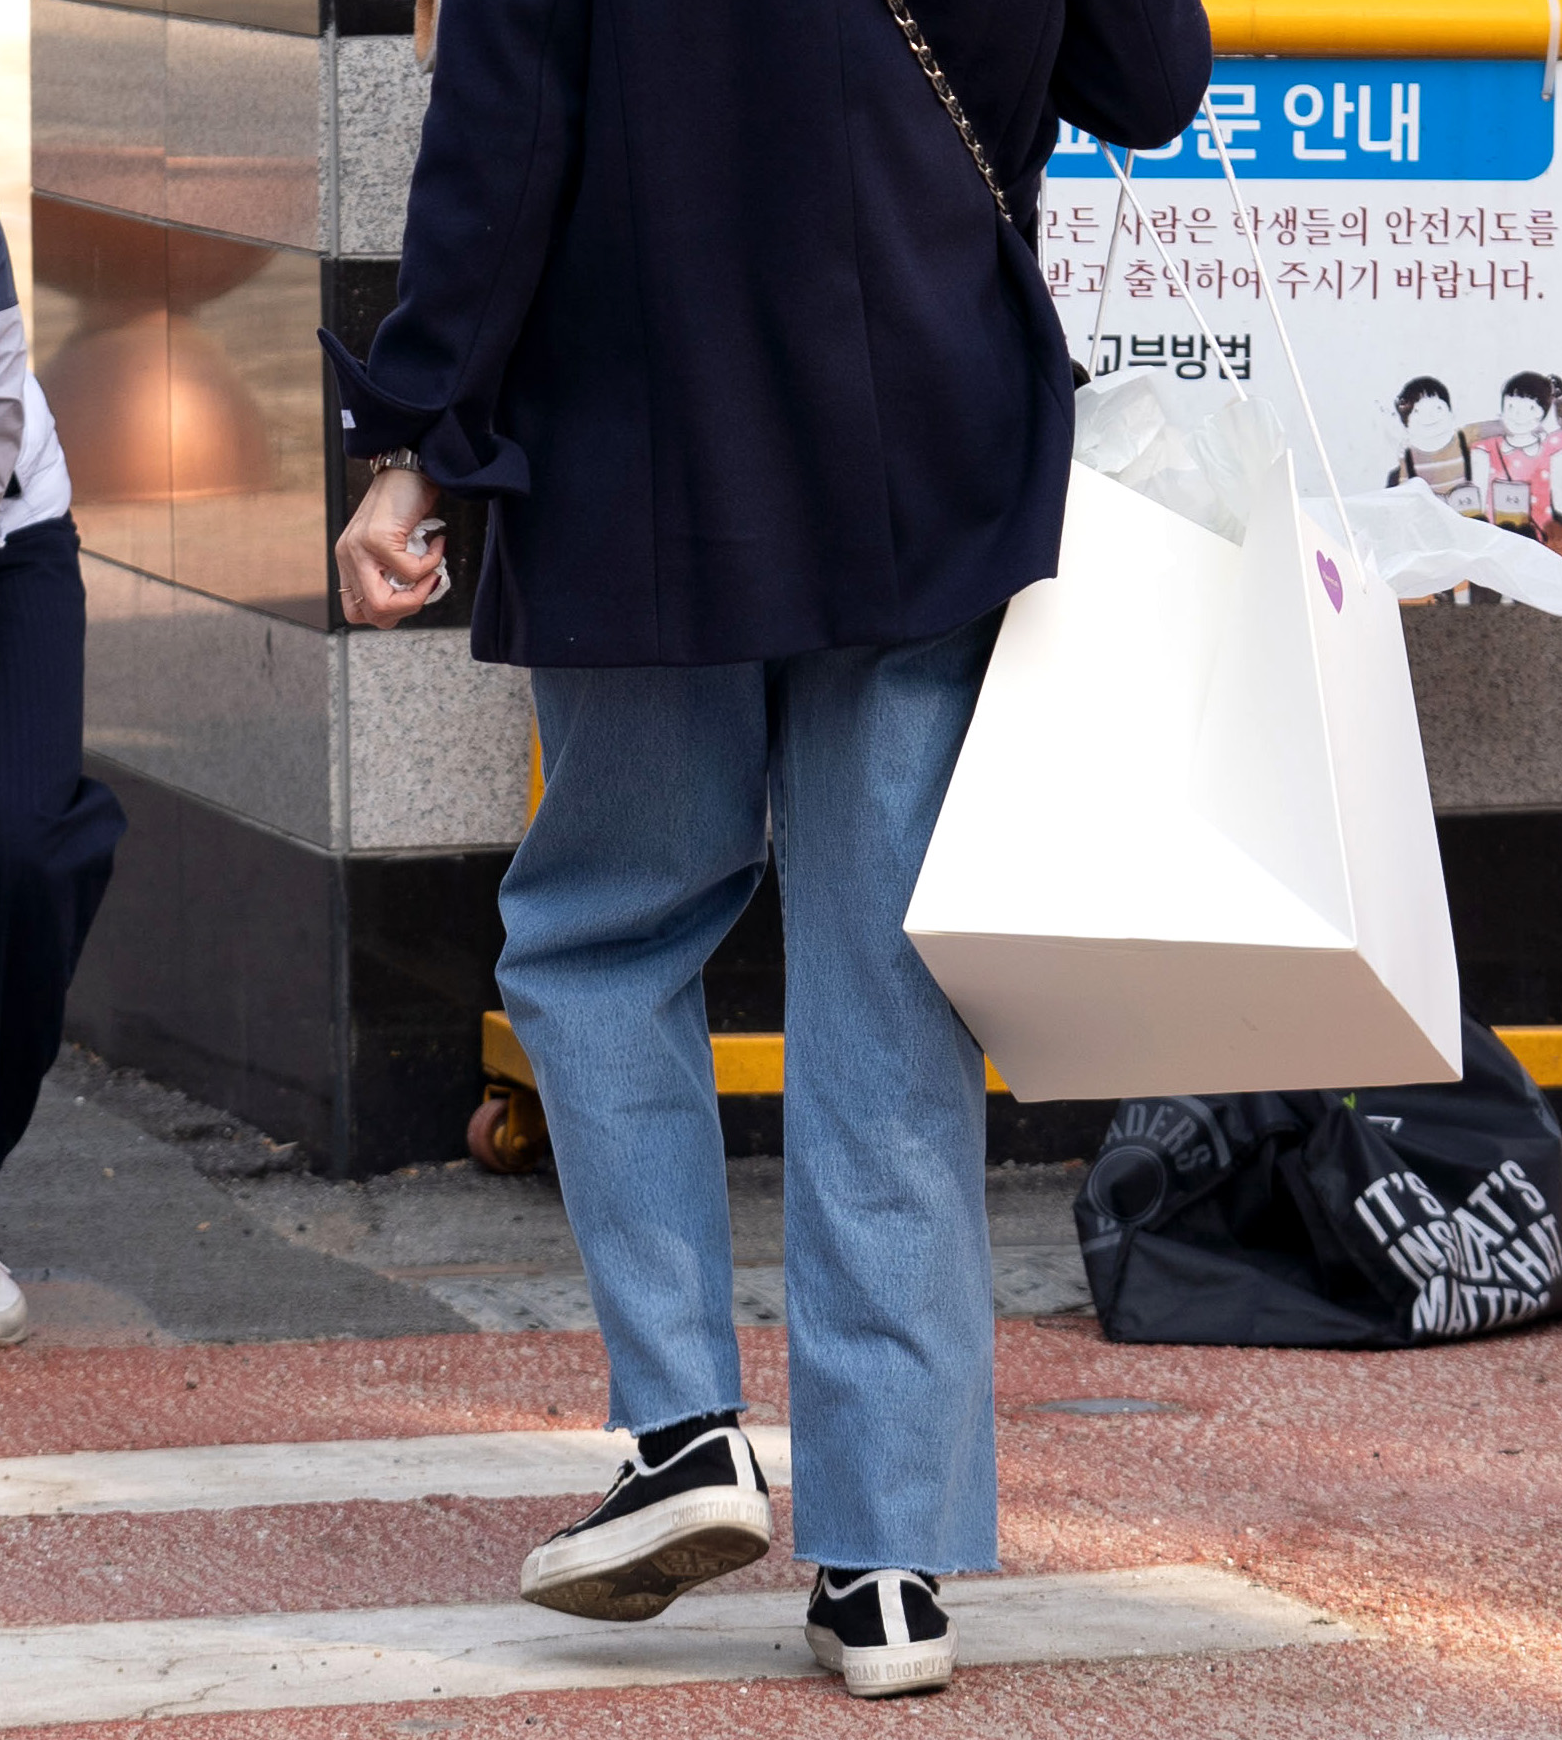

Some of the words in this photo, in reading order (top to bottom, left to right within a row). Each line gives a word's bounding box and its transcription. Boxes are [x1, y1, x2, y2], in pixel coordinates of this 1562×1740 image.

[1282, 82, 1421, 162] 안내
[1119, 204, 1218, 247] 사람은
[1232, 205, 1369, 248] 학생들의
[1385, 205, 1560, 249] 안전지도를
[1123, 258, 1261, 300] 출입하여
[1276, 260, 1379, 301] 주시기
[1394, 260, 1545, 302] 바랍니다.
[1354, 1170, 1447, 1246] IT'S
[885, 1658, 924, 1681] DIOR
